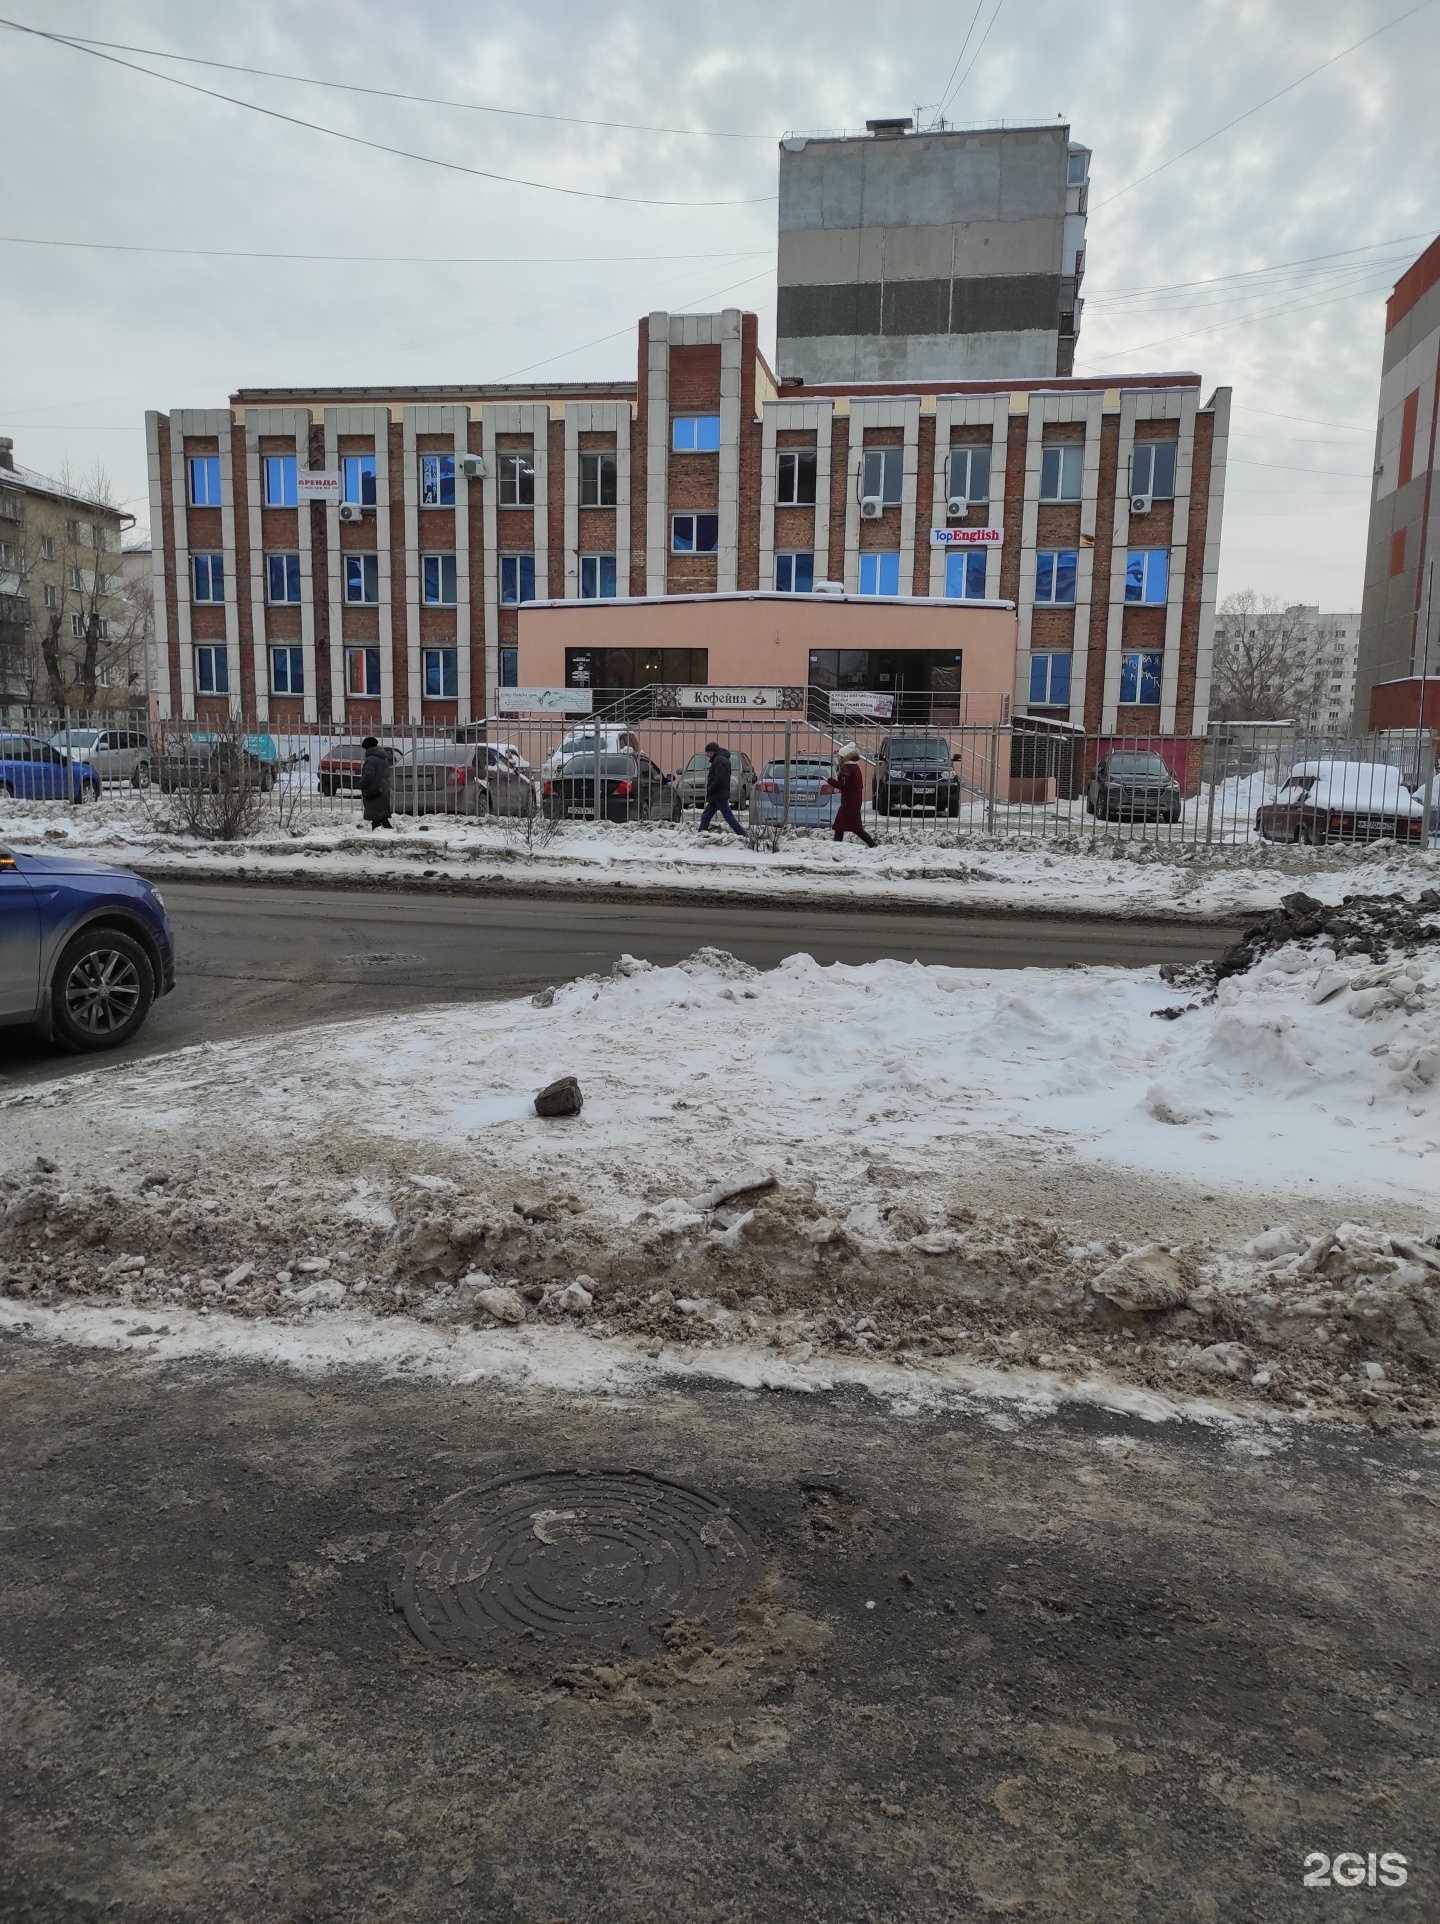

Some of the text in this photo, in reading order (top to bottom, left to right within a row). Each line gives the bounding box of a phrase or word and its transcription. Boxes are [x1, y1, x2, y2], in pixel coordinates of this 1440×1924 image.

[298, 479, 338, 487] АРЕНДА
[935, 529, 1000, 543] TopEnglish
[694, 691, 747, 706] Кофейня
